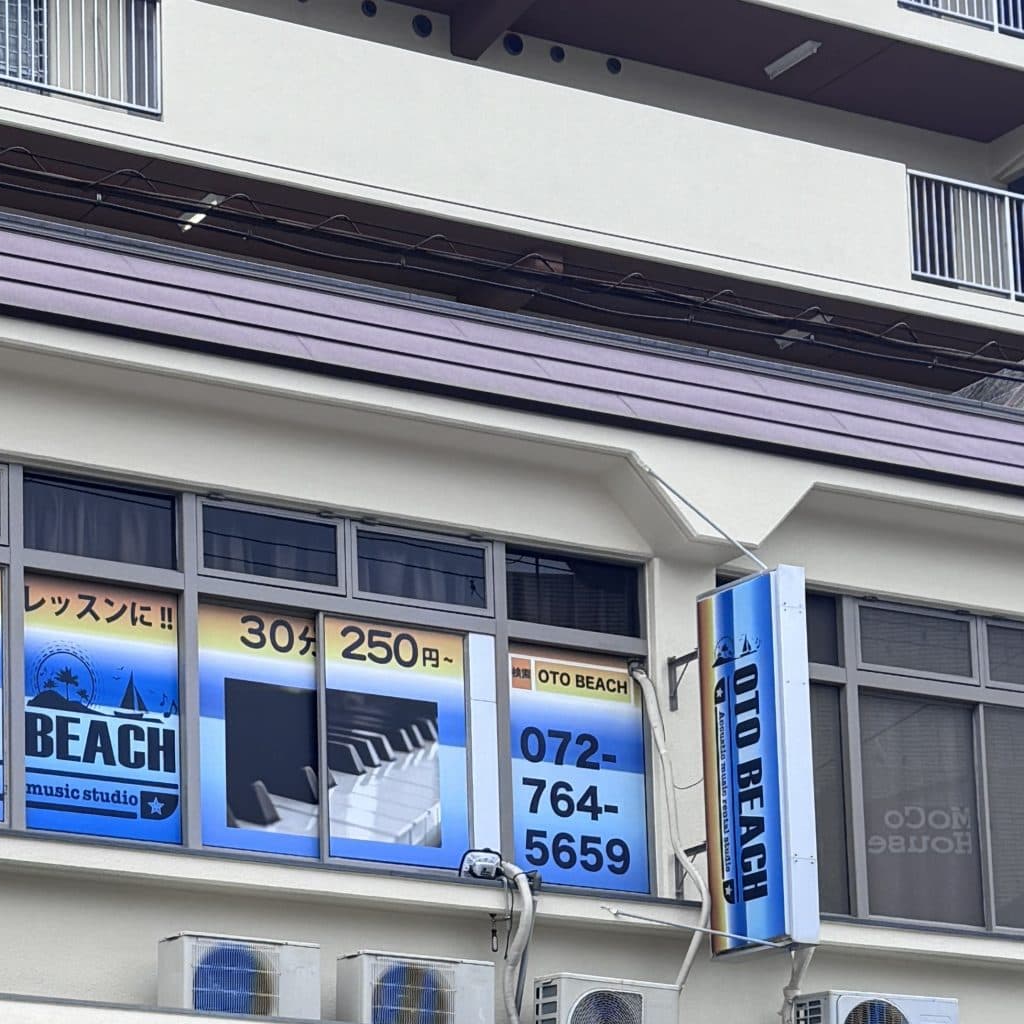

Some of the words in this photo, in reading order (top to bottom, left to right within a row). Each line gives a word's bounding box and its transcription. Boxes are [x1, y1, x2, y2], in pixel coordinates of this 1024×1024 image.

[538, 669, 571, 686] OTO
[575, 674, 628, 694] BEACH
[733, 663, 760, 750] OTO
[24, 711, 176, 773] BEACH
[519, 726, 617, 771] 072-
[26, 782, 81, 801] music
[82, 789, 138, 807] studio
[522, 777, 619, 821] 764-
[524, 829, 631, 875] 5659
[738, 758, 768, 902] BEACH
